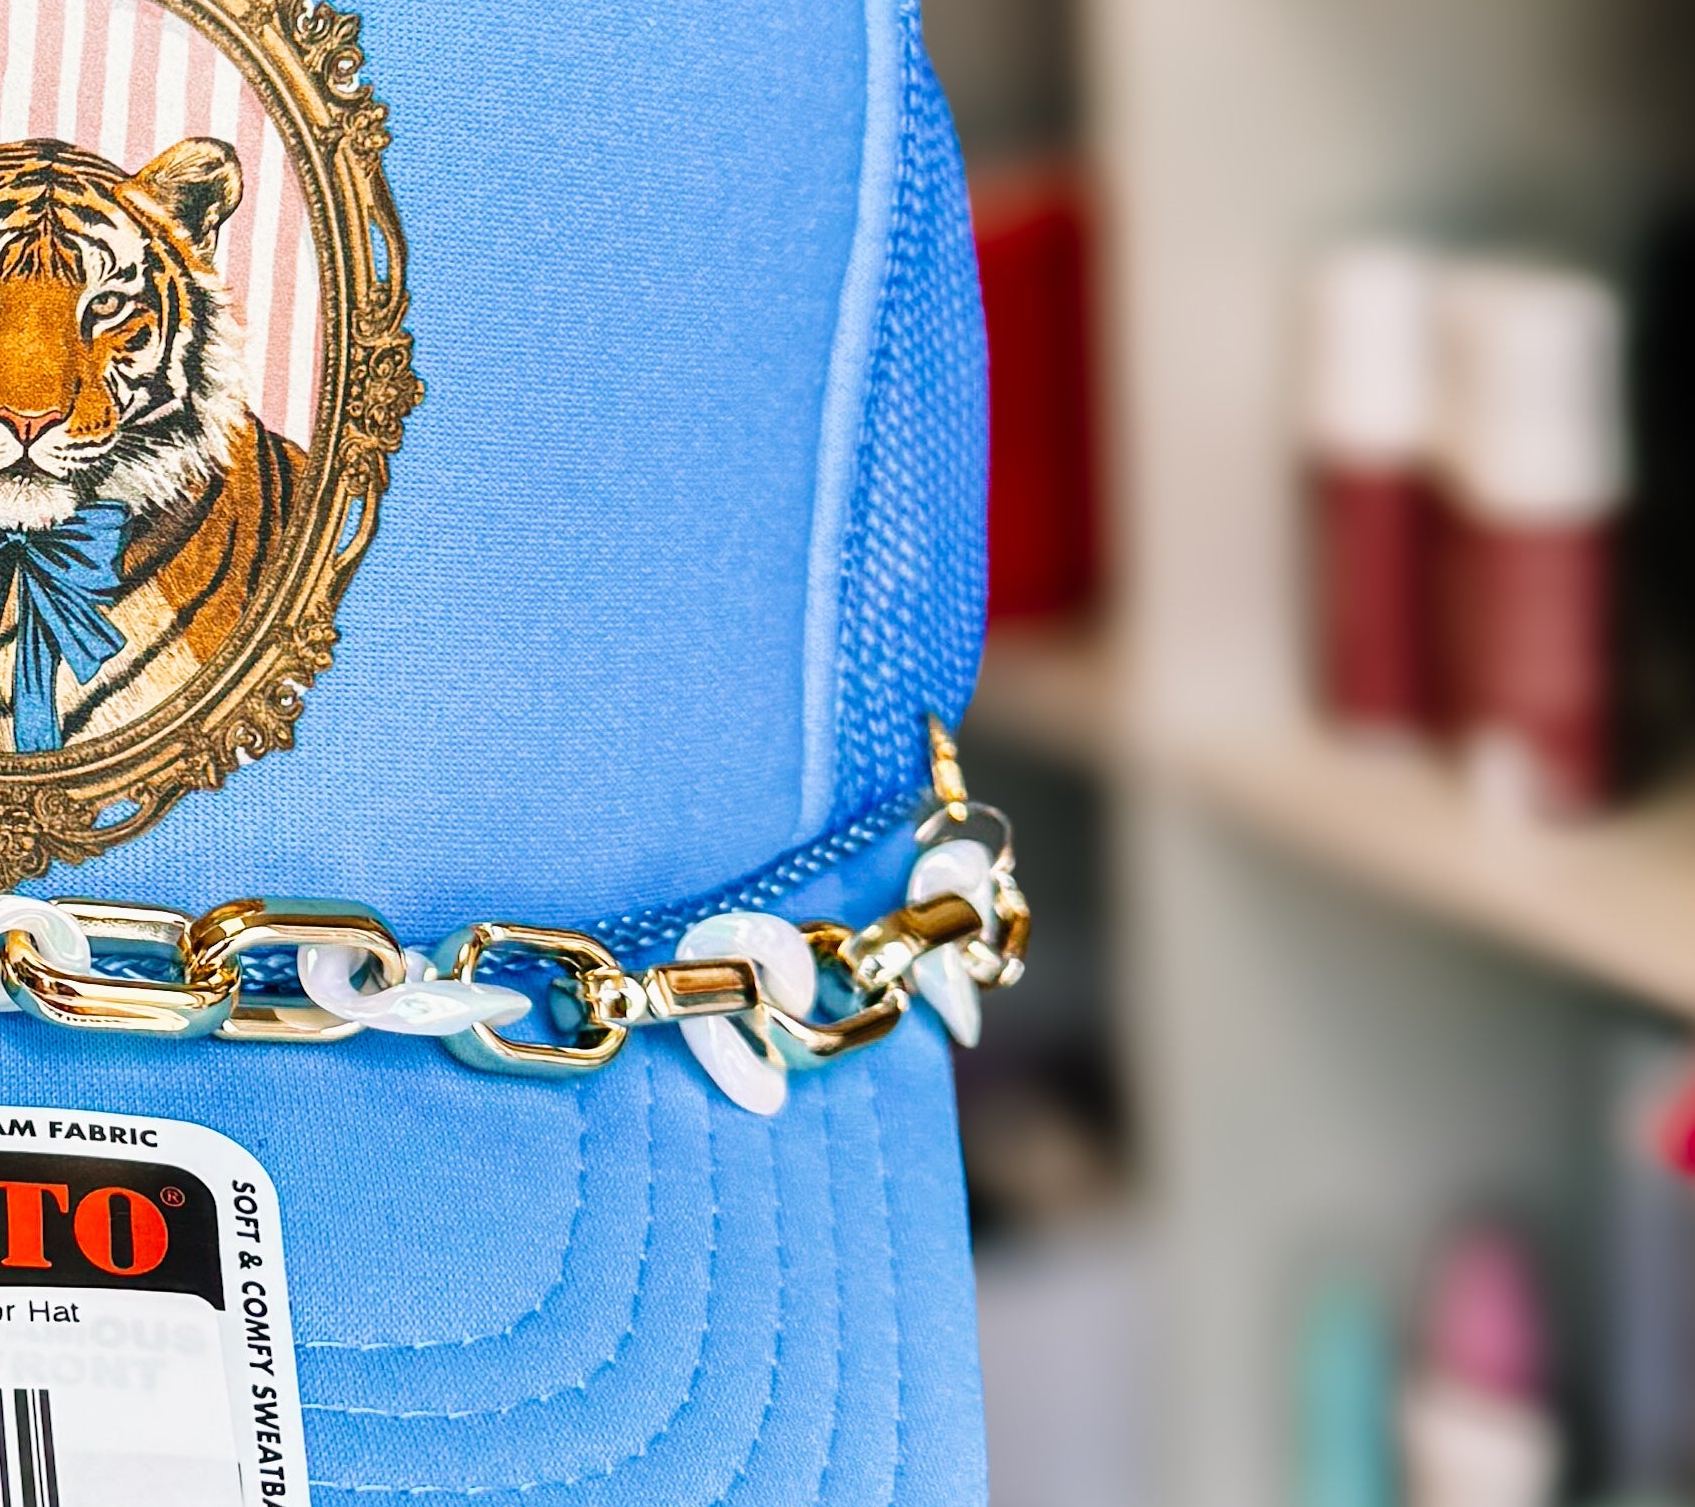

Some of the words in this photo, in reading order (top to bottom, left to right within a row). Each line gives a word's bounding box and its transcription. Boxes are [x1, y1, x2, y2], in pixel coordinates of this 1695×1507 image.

[48, 1121, 160, 1148] FABRIC
[231, 1179, 261, 1243] SOFT
[238, 1249, 264, 1271] &
[28, 1300, 81, 1323] Hat
[240, 1280, 275, 1377] COMFY
